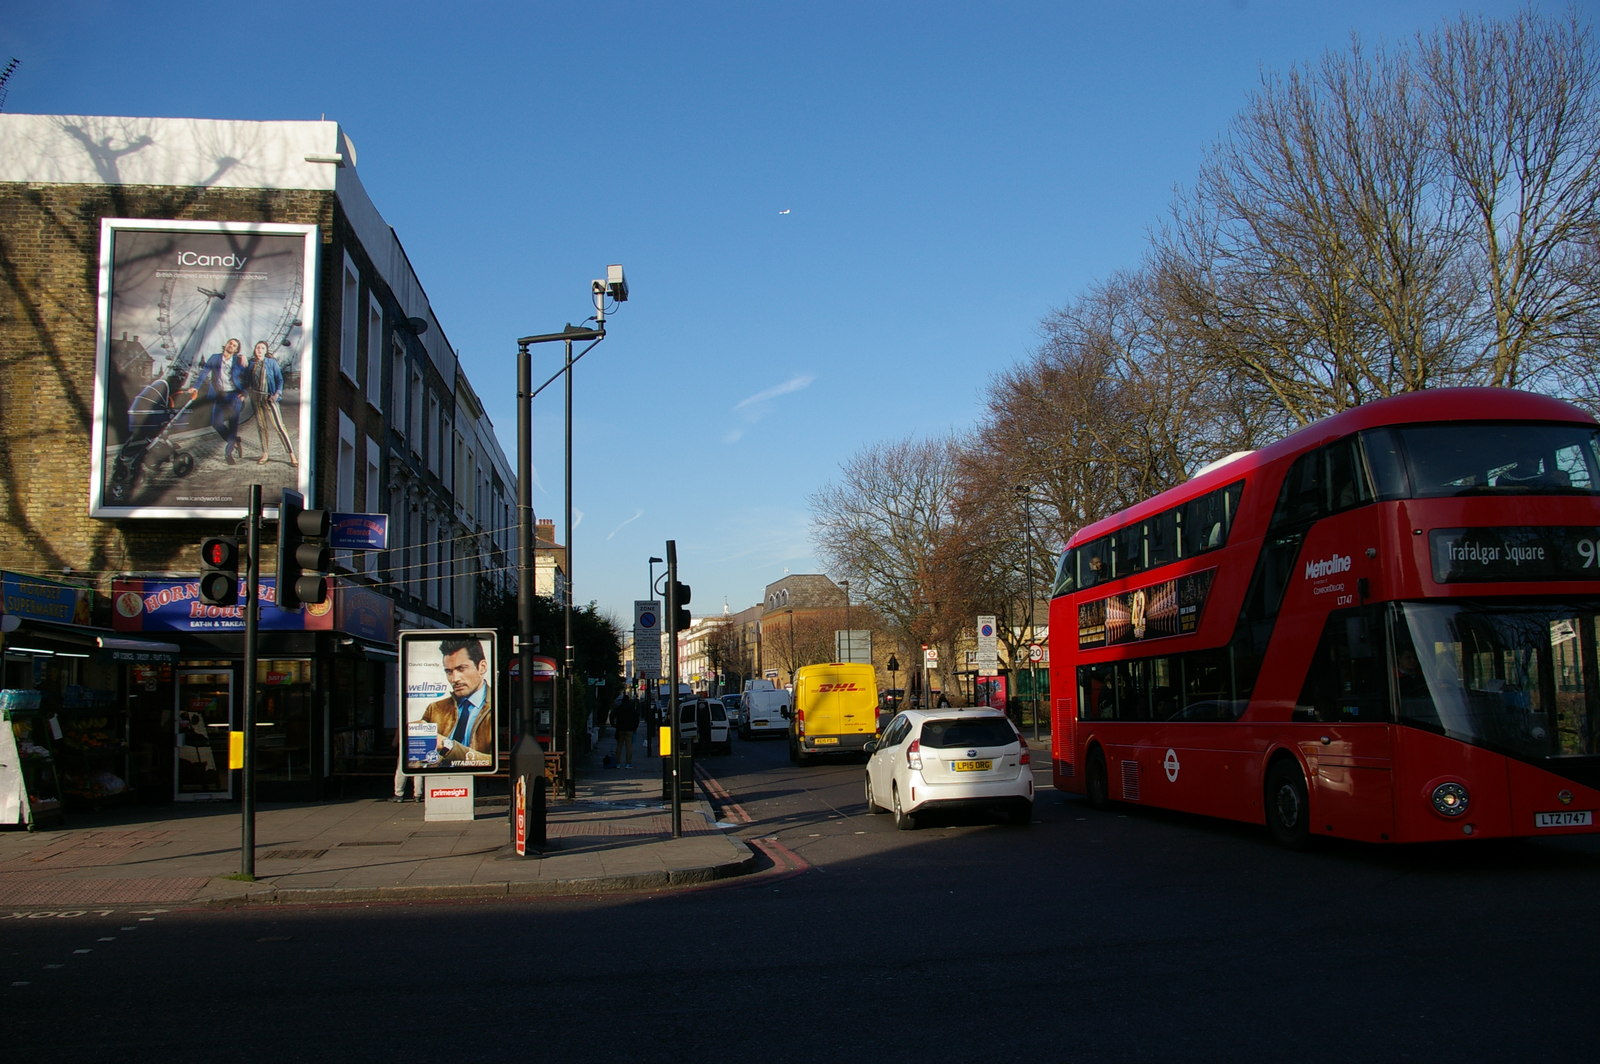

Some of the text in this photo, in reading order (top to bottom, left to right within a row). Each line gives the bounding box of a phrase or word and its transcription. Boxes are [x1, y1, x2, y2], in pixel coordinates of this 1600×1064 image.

[177, 251, 247, 270] iCandy
[1447, 541, 1545, 566] Trafalgar Square
[1305, 554, 1352, 580] Metroline
[143, 583, 200, 615] HORN
[1337, 594, 1353, 606] LT747
[188, 601, 245, 619] Hous
[190, 620, 213, 628] EAT-IN
[221, 620, 246, 628] TAKEA
[1030, 648, 1041, 657] 20
[408, 682, 448, 692] wellman
[819, 683, 858, 693] DHL
[957, 761, 974, 770] LP15
[433, 789, 466, 798] primesight
[0, 909, 116, 920] LOOK
